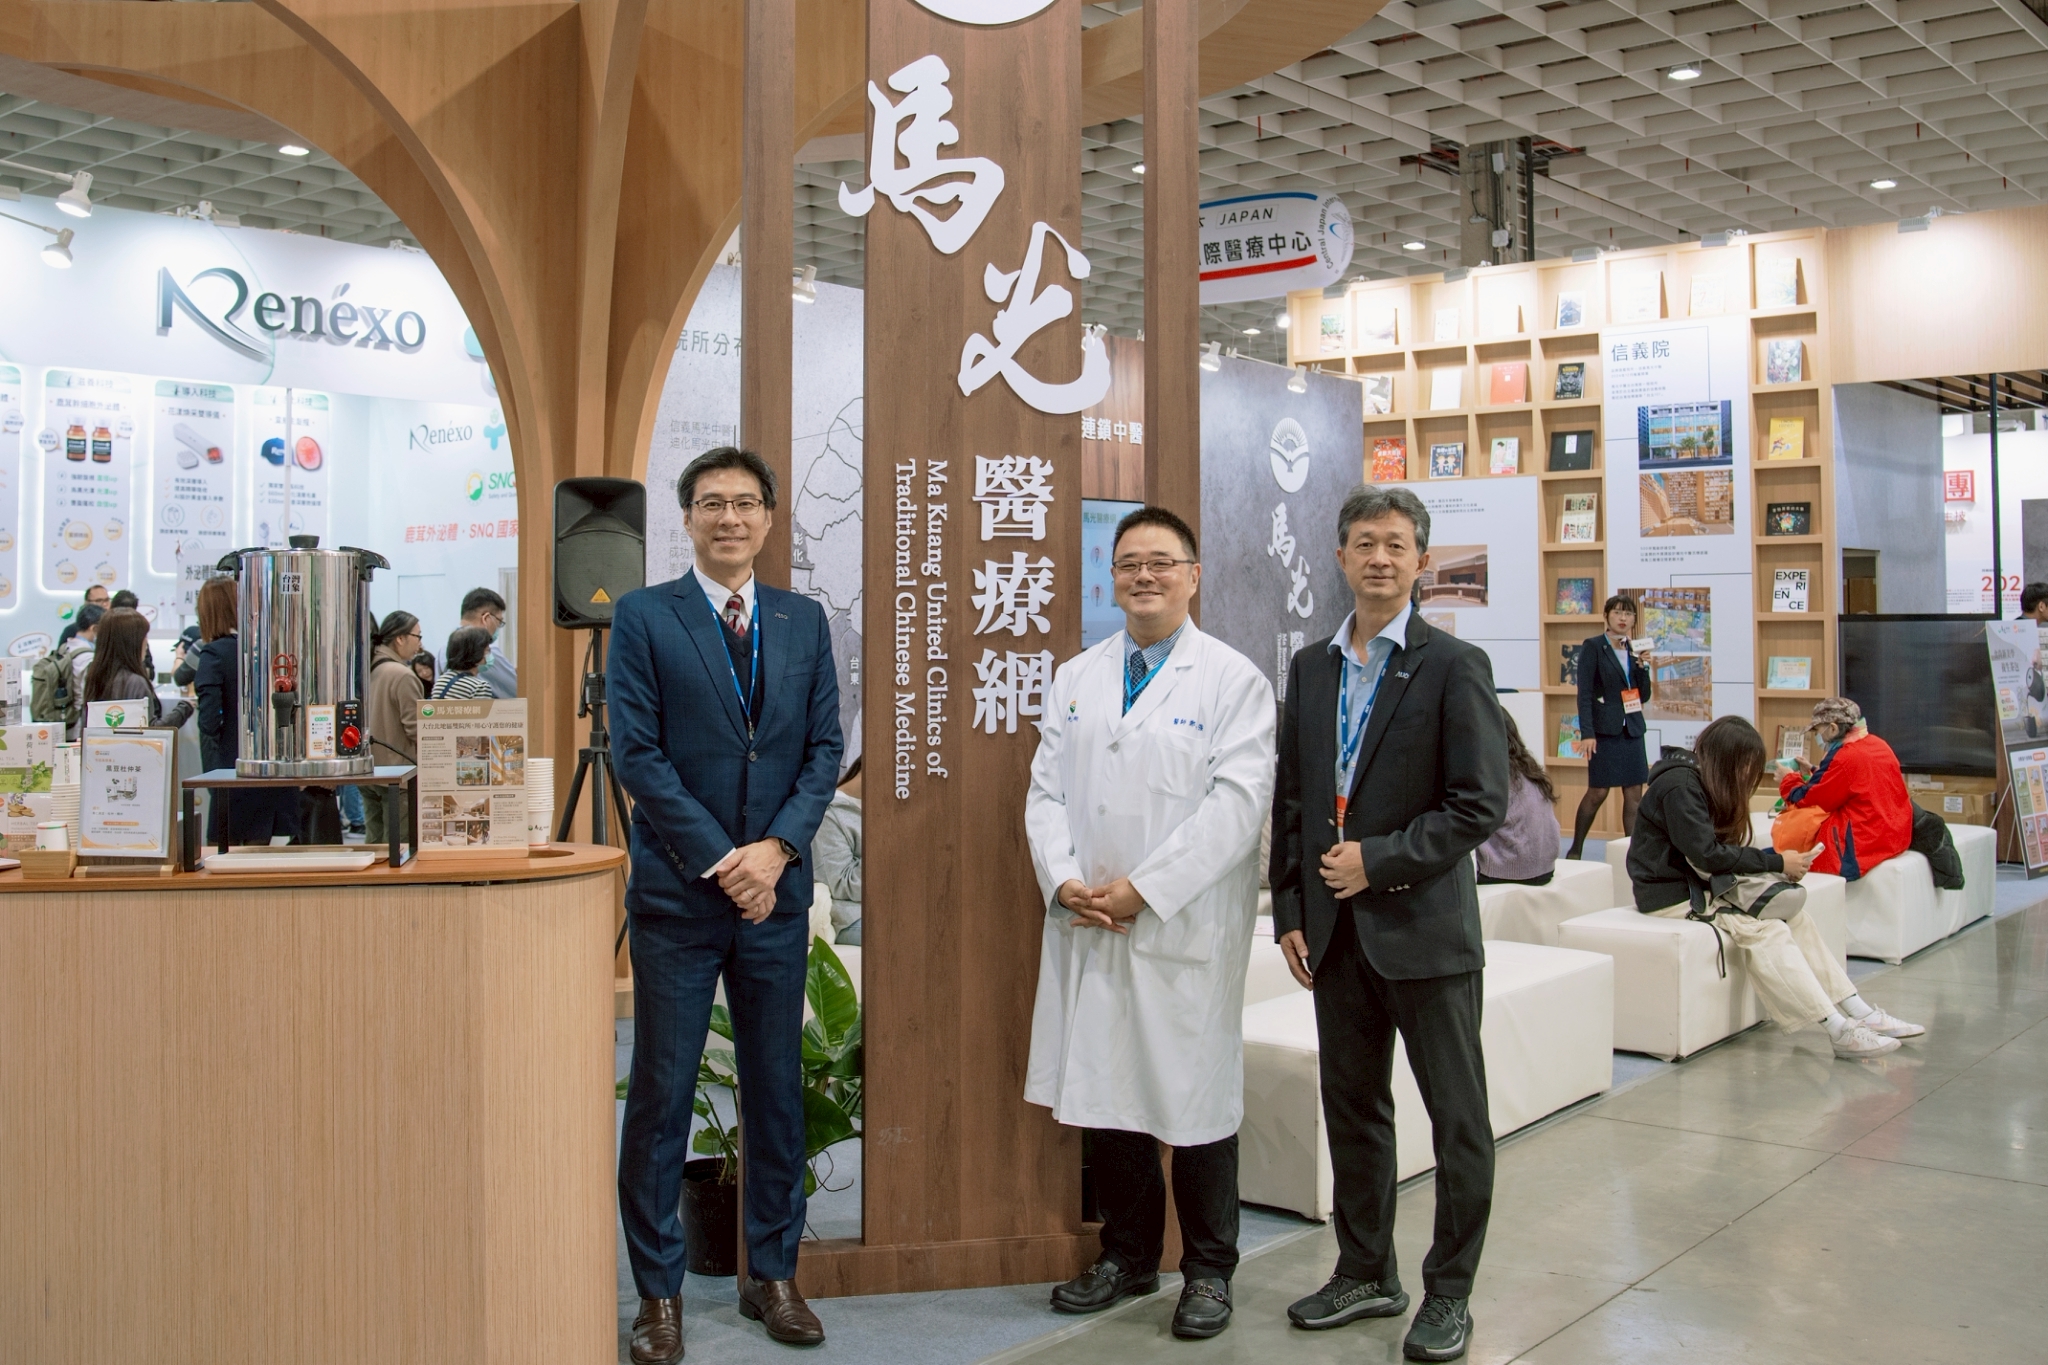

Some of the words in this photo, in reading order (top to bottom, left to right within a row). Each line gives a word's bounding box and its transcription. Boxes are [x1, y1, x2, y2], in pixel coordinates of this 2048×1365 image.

[1219, 206, 1276, 226] JAPAN
[1317, 208, 1328, 236] Japan
[1199, 230, 1313, 266] 際醫療中心
[158, 266, 427, 357] Renéxo
[1610, 339, 1671, 363] 信義院
[409, 420, 473, 455] Renéxo
[1081, 415, 1144, 446] 連鎖中醫
[927, 459, 949, 498] Ma
[469, 522, 494, 539] SNQ
[895, 457, 918, 589] Traditional
[793, 532, 804, 563] 彰化
[921, 502, 949, 578] Kuang
[1775, 571, 1807, 581] EXPE
[1795, 581, 1806, 591] RI
[1774, 590, 1790, 600] EN
[1788, 601, 1805, 610] CE
[926, 582, 949, 662] United
[895, 591, 918, 688] Chinese
[850, 655, 860, 686] 台東
[436, 705, 481, 716] 馬光醫療網
[926, 666, 950, 748] Clinics
[895, 691, 918, 801] Medicine
[105, 765, 142, 773] 黑豆杜仲茶
[926, 751, 949, 778] of
[1333, 1280, 1381, 1311] GORE-TEX
